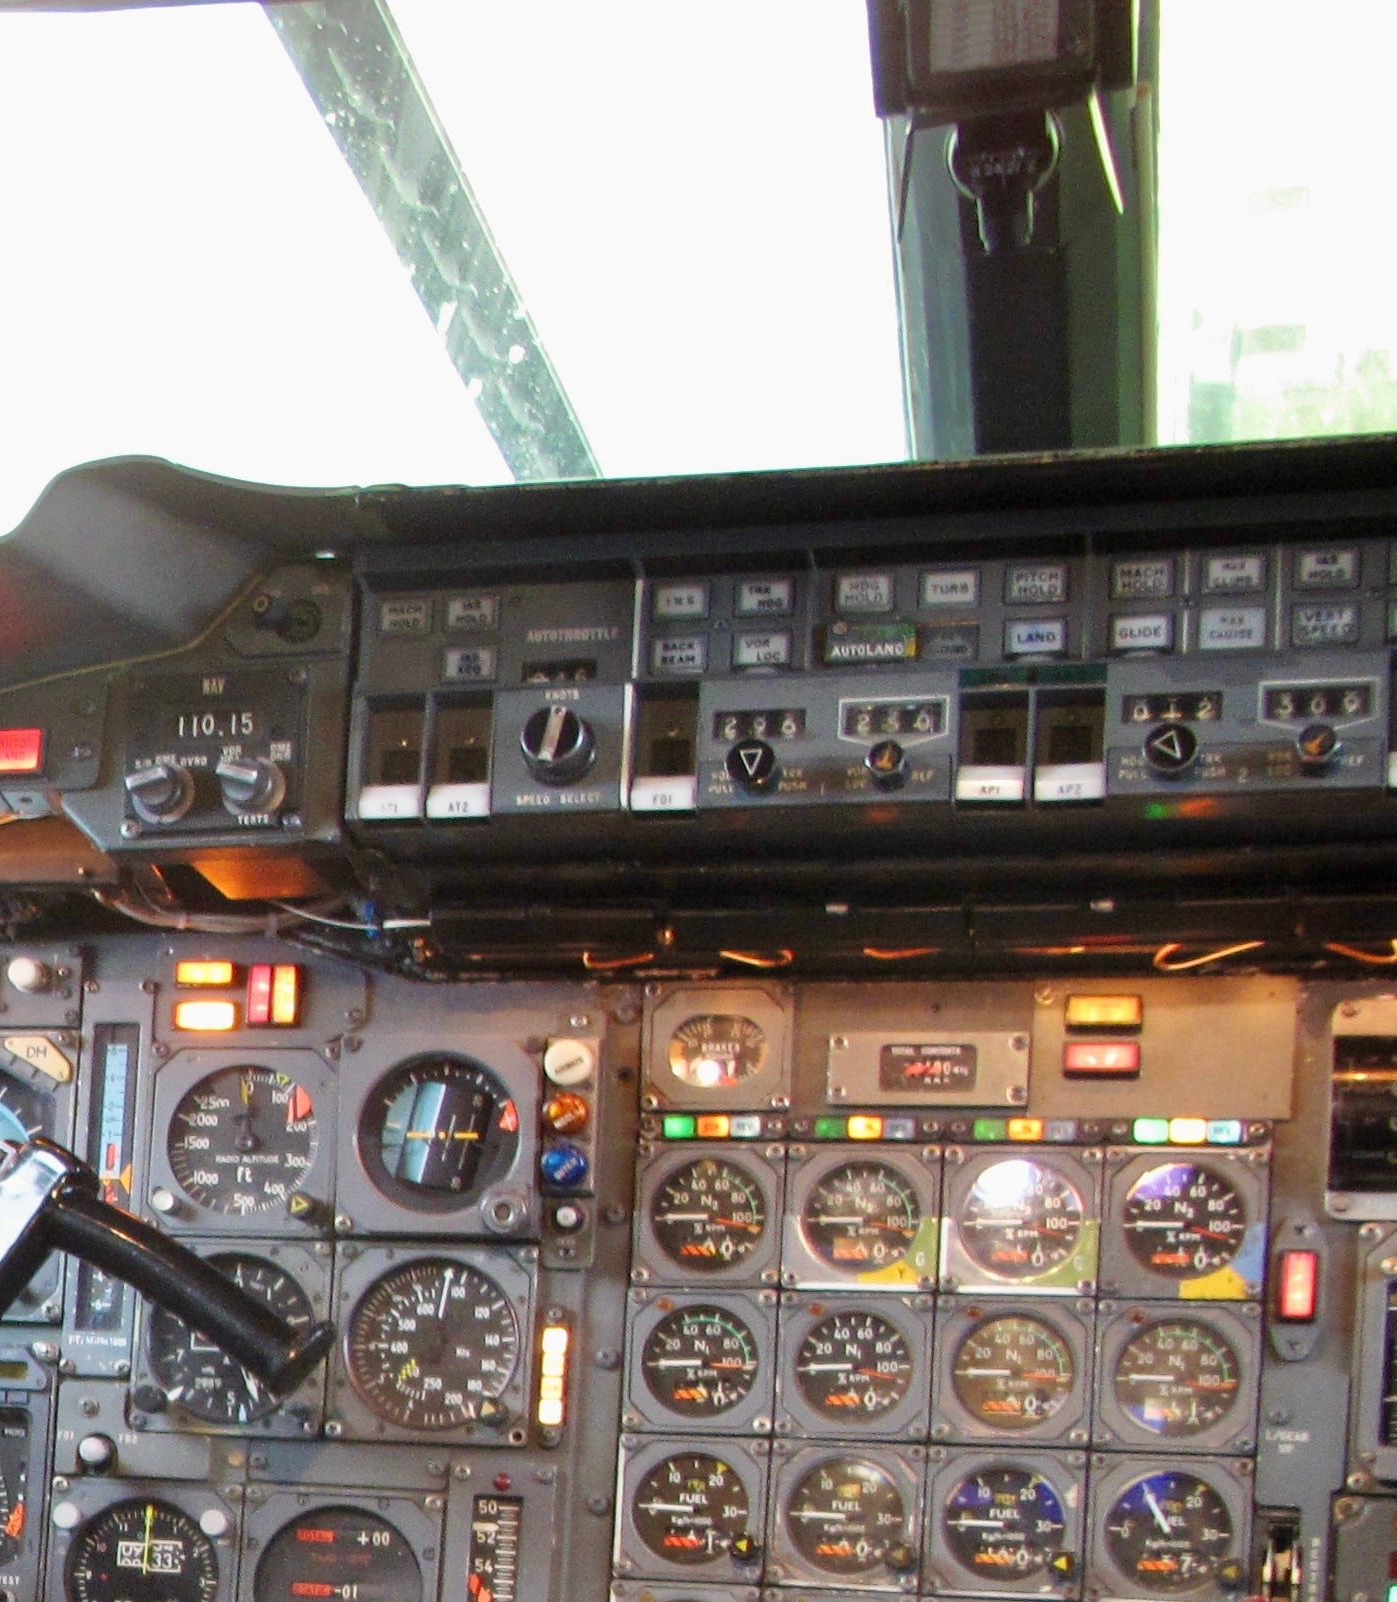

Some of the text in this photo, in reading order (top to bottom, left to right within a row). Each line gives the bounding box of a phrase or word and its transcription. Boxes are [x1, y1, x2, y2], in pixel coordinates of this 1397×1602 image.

[1014, 571, 1060, 584] PITCH
[1016, 631, 1056, 644] LAND
[1118, 627, 1162, 640] GLIDE
[831, 643, 906, 658] AUTOLAND
[202, 677, 226, 695] NAV
[177, 712, 254, 738] 110.15
[447, 801, 469, 814] AT2
[183, 1137, 210, 1150] 1500
[284, 1154, 306, 1168] 300
[193, 1171, 219, 1185] 1000
[236, 1166, 252, 1183] ft
[263, 1181, 286, 1195] 400
[1189, 1185, 1207, 1198] 60
[233, 1192, 255, 1207] 500
[732, 1210, 753, 1223] 100
[1045, 1217, 1068, 1230] 100
[1209, 1220, 1232, 1233] 100
[856, 1328, 874, 1340] 60
[876, 1361, 898, 1373] 100
[679, 1493, 708, 1504] FUEL
[1019, 1488, 1036, 1500] 20
[478, 1500, 498, 1515] 50
[722, 1506, 738, 1519] 30
[831, 1500, 862, 1512] FUEL
[989, 1508, 1021, 1520] FUEL
[356, 1532, 392, 1548] +00
[473, 1558, 494, 1573] 54
